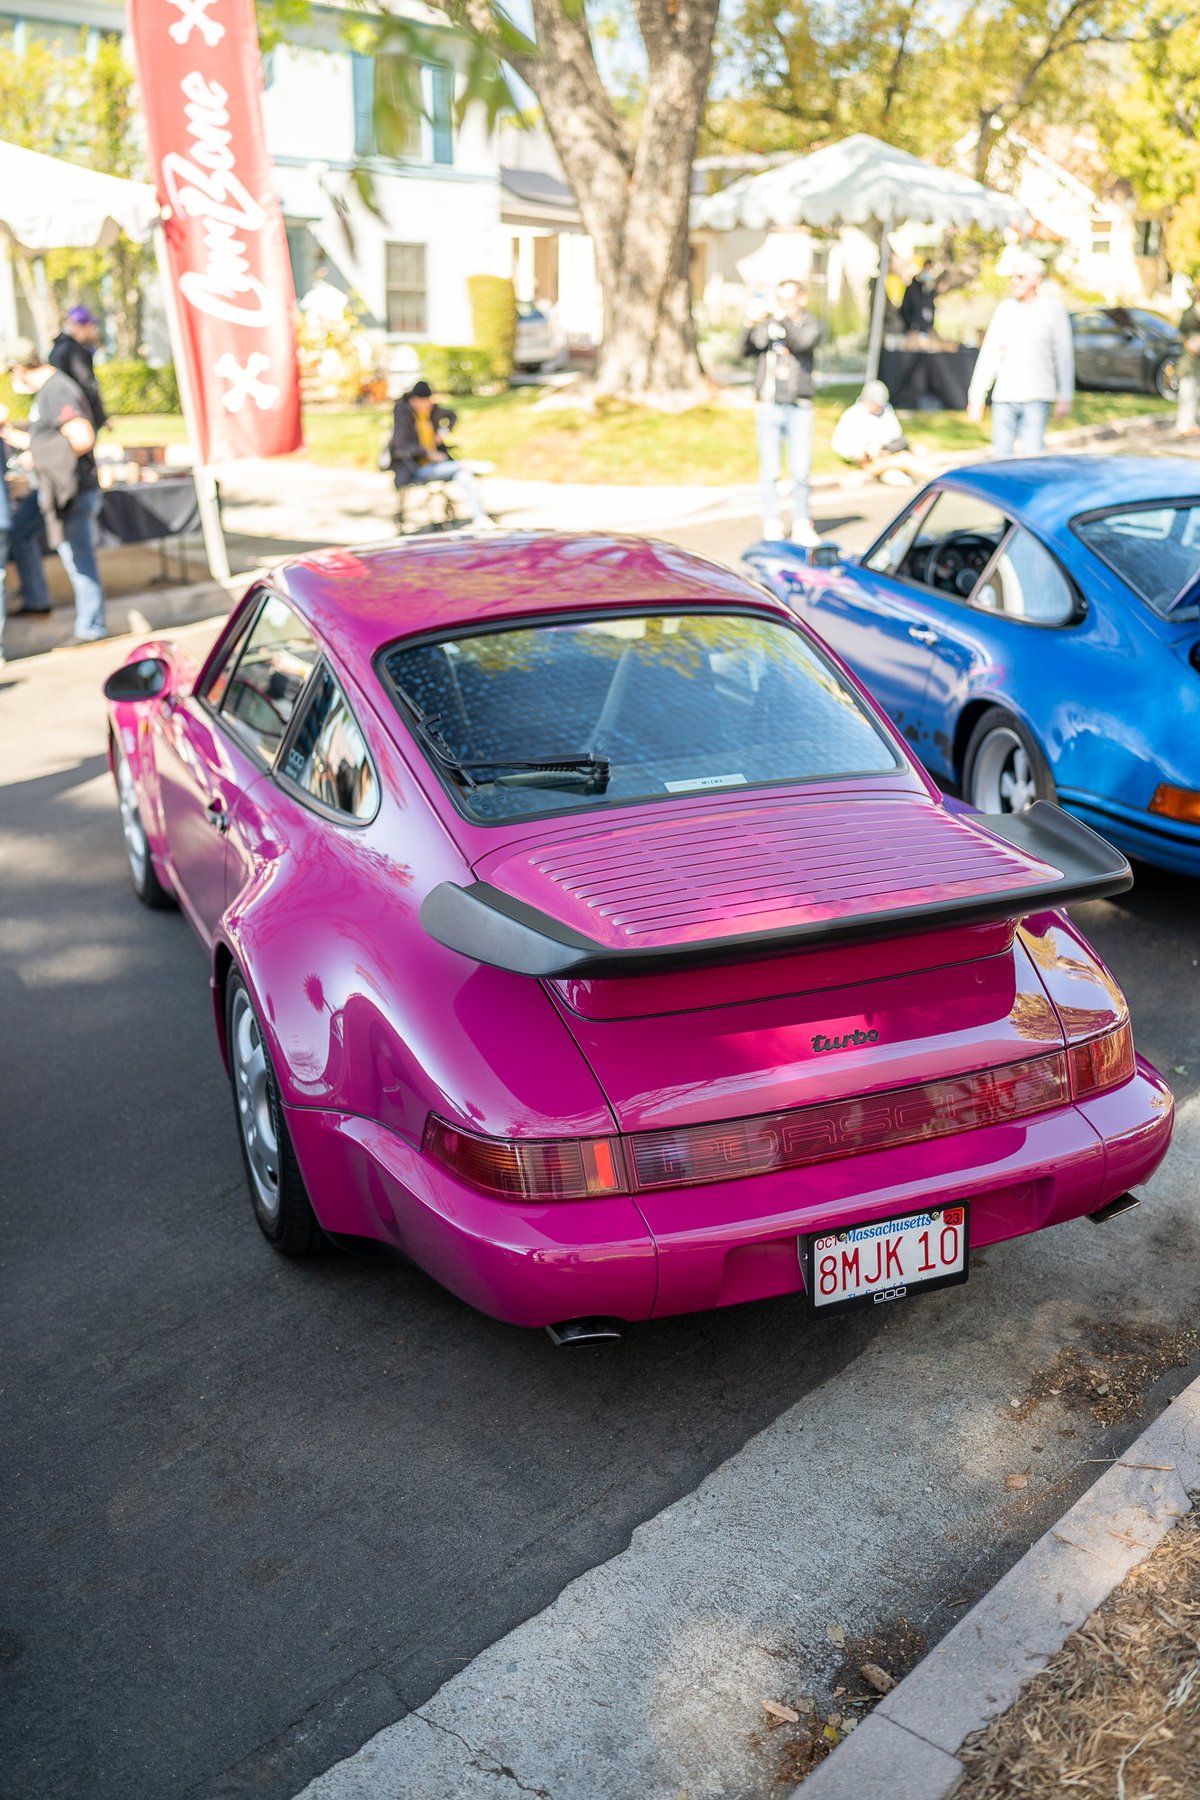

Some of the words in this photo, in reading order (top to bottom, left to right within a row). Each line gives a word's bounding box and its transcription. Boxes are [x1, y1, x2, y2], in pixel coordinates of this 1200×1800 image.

[811, 1029, 879, 1053] turbo
[844, 1213, 932, 1244] Massachusetts
[945, 1213, 960, 1225] 23
[816, 1236, 838, 1250] OCT
[819, 1236, 904, 1295] 8MJK
[918, 1226, 958, 1272] 10
